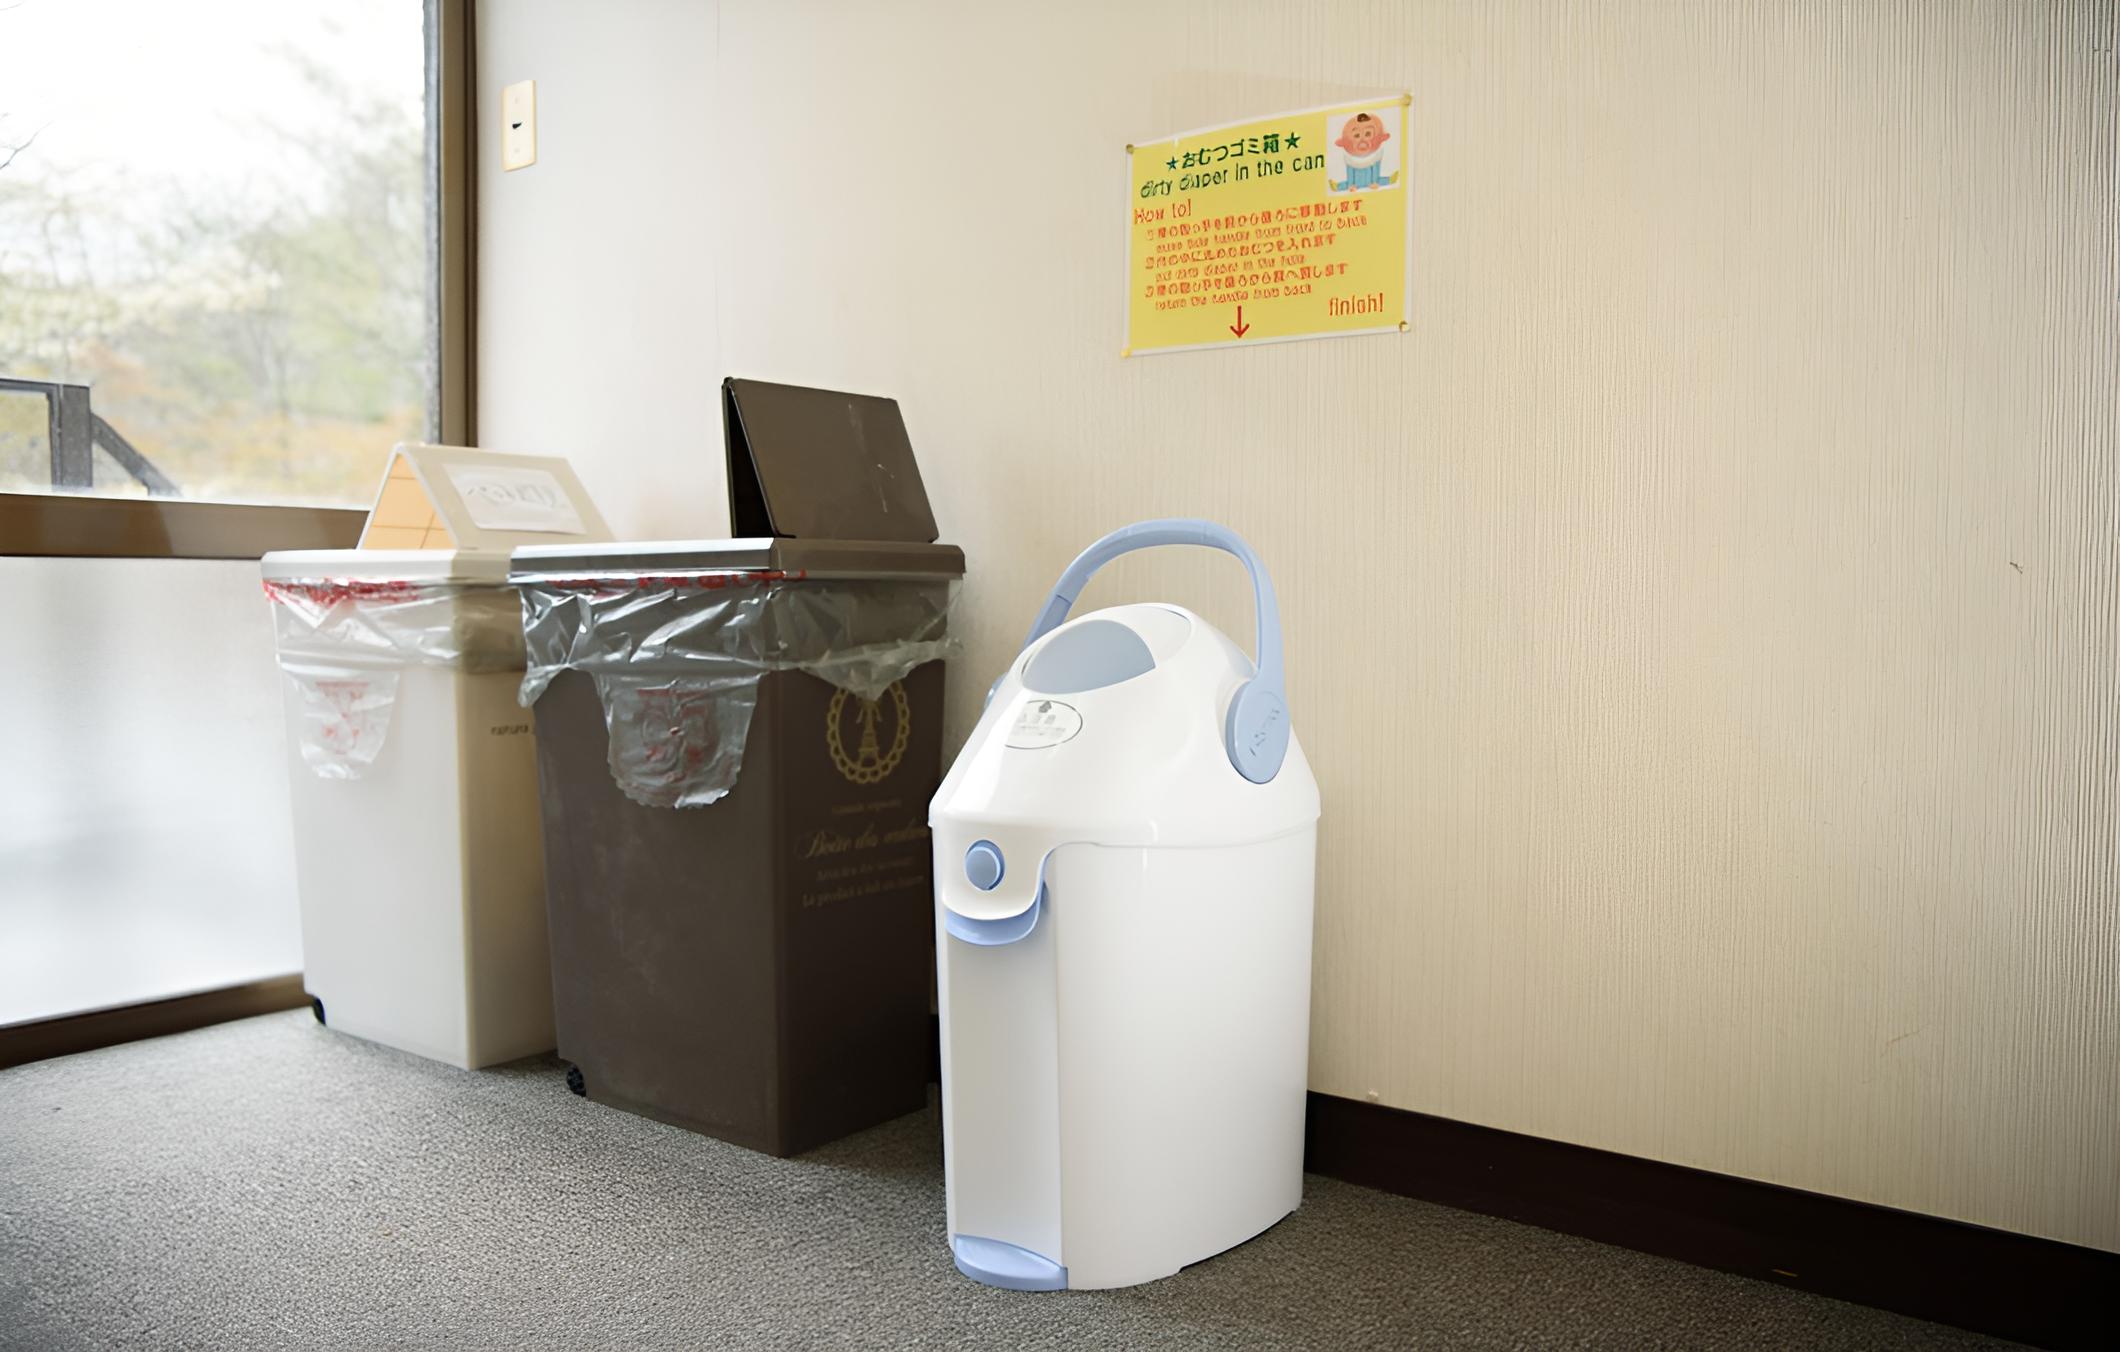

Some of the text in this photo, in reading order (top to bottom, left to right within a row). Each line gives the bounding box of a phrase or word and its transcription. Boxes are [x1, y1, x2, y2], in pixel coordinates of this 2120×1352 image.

[1235, 163, 1249, 181] in
[1257, 159, 1283, 177] the
[1293, 154, 1325, 172] can
[1134, 208, 1165, 224] How
